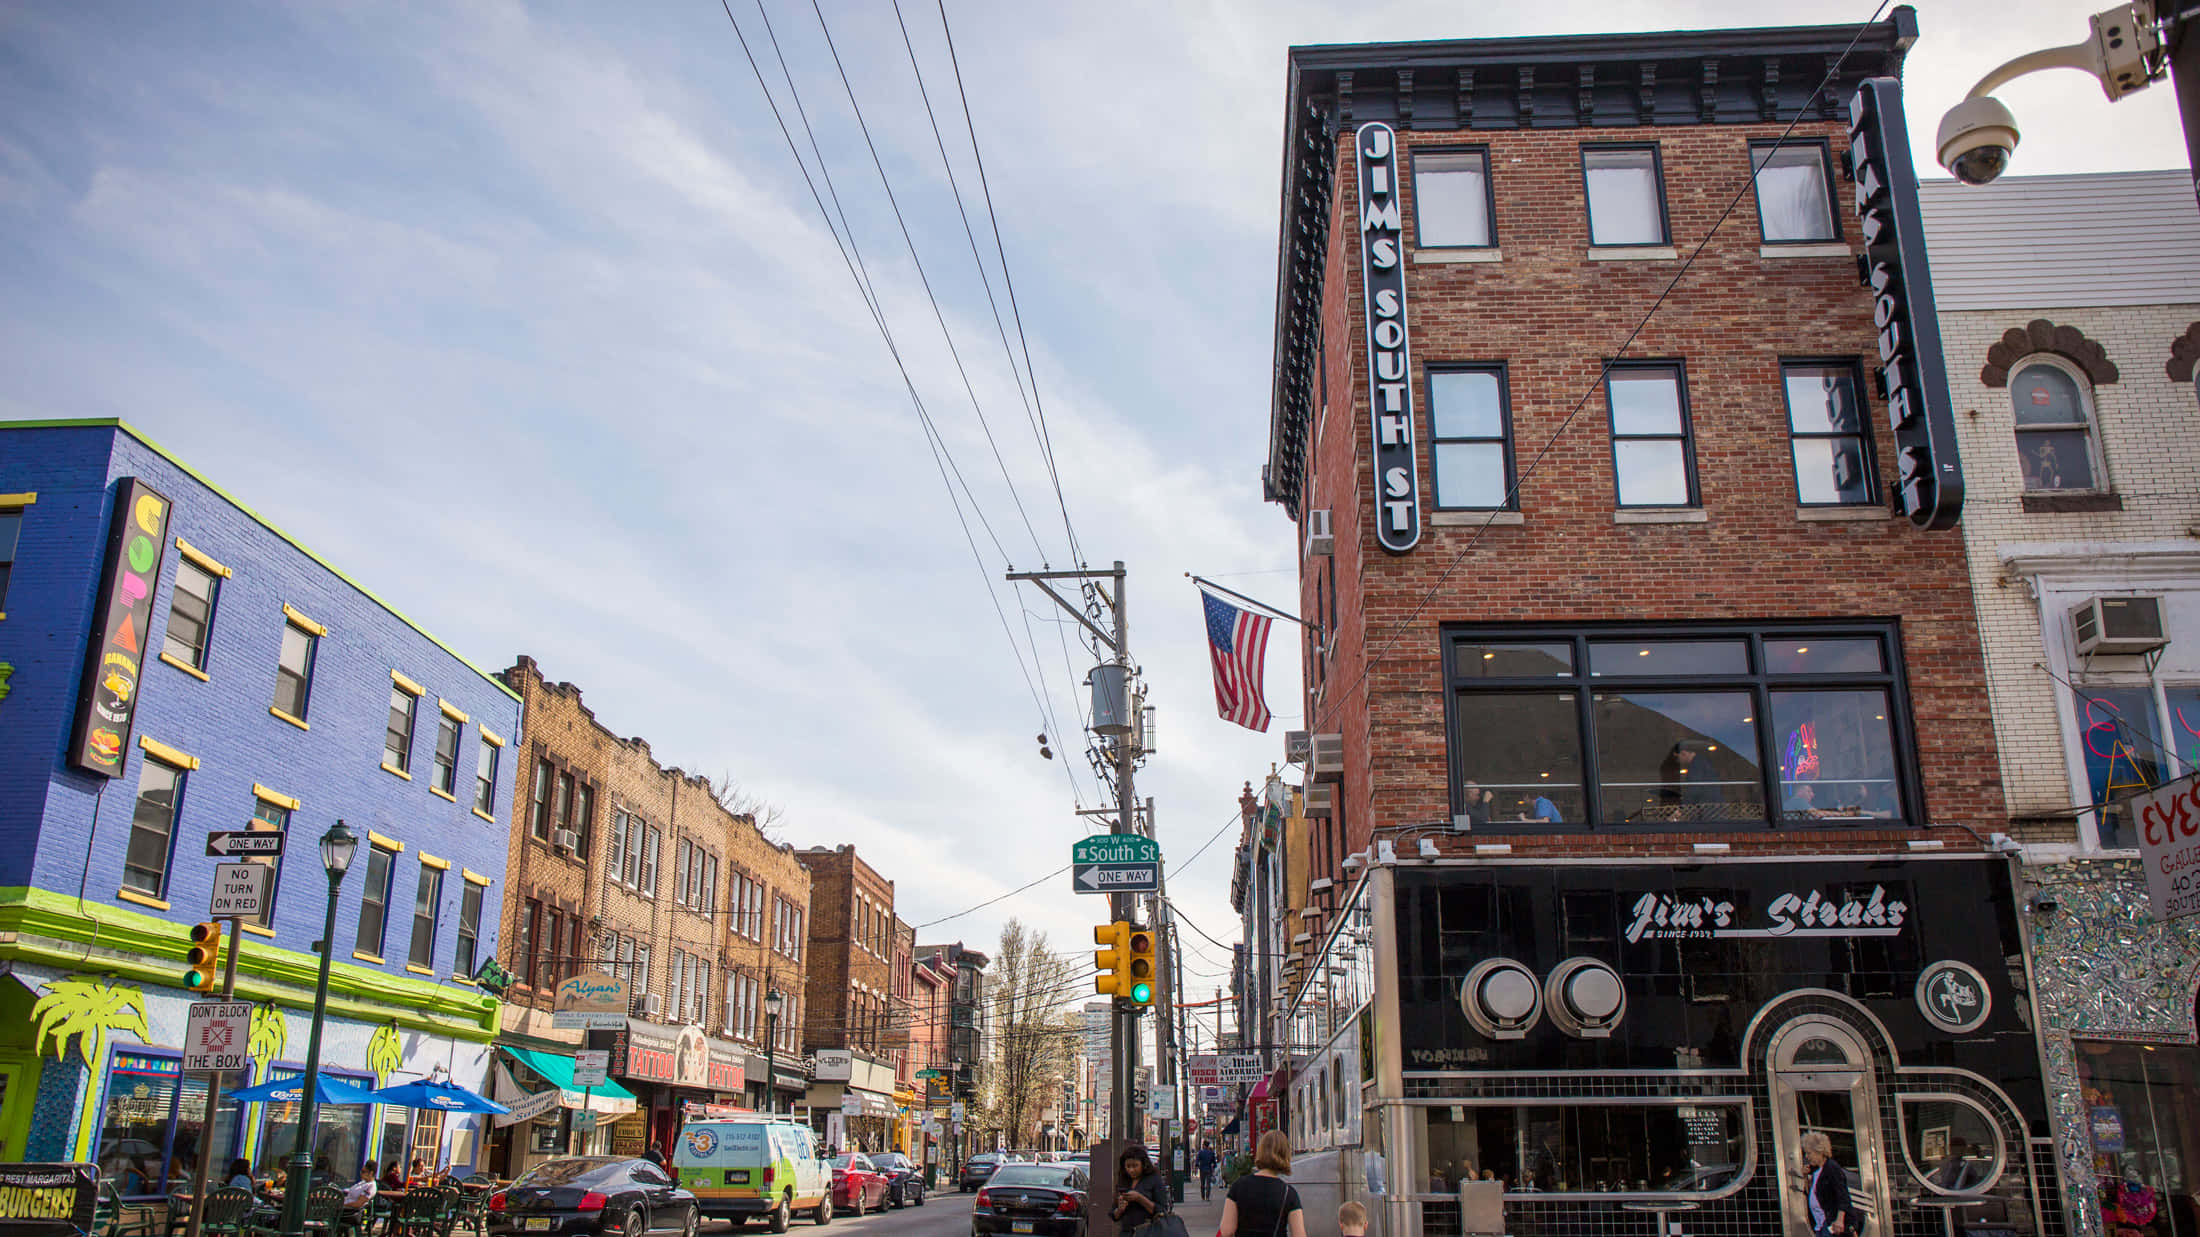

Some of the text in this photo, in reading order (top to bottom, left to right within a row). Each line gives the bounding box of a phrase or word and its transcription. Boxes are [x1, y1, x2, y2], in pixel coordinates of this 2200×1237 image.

[1364, 131, 1414, 531] JIMS SOUTH ST
[1871, 262, 1911, 431] SOUTH
[1898, 446, 1921, 517] ST
[229, 839, 274, 849] ONE WAY
[1110, 836, 1120, 845] W
[1089, 844, 1155, 862] South St
[232, 869, 249, 879] NO
[1098, 871, 1148, 883] ONE WAY
[224, 883, 254, 894] TURN
[215, 898, 257, 909] ON RED
[1624, 883, 1908, 944] Jim's Steaks
[1656, 930, 1687, 938] SINCE
[560, 980, 621, 999] Alyan's
[219, 1006, 249, 1017] BLOCK
[188, 1054, 242, 1068] THE BOX
[629, 1046, 675, 1080] TATTOO
[709, 1061, 745, 1089] TATTOO
[27, 1174, 77, 1185] MARGARITAS
[0, 1186, 78, 1219] BURGERS!
